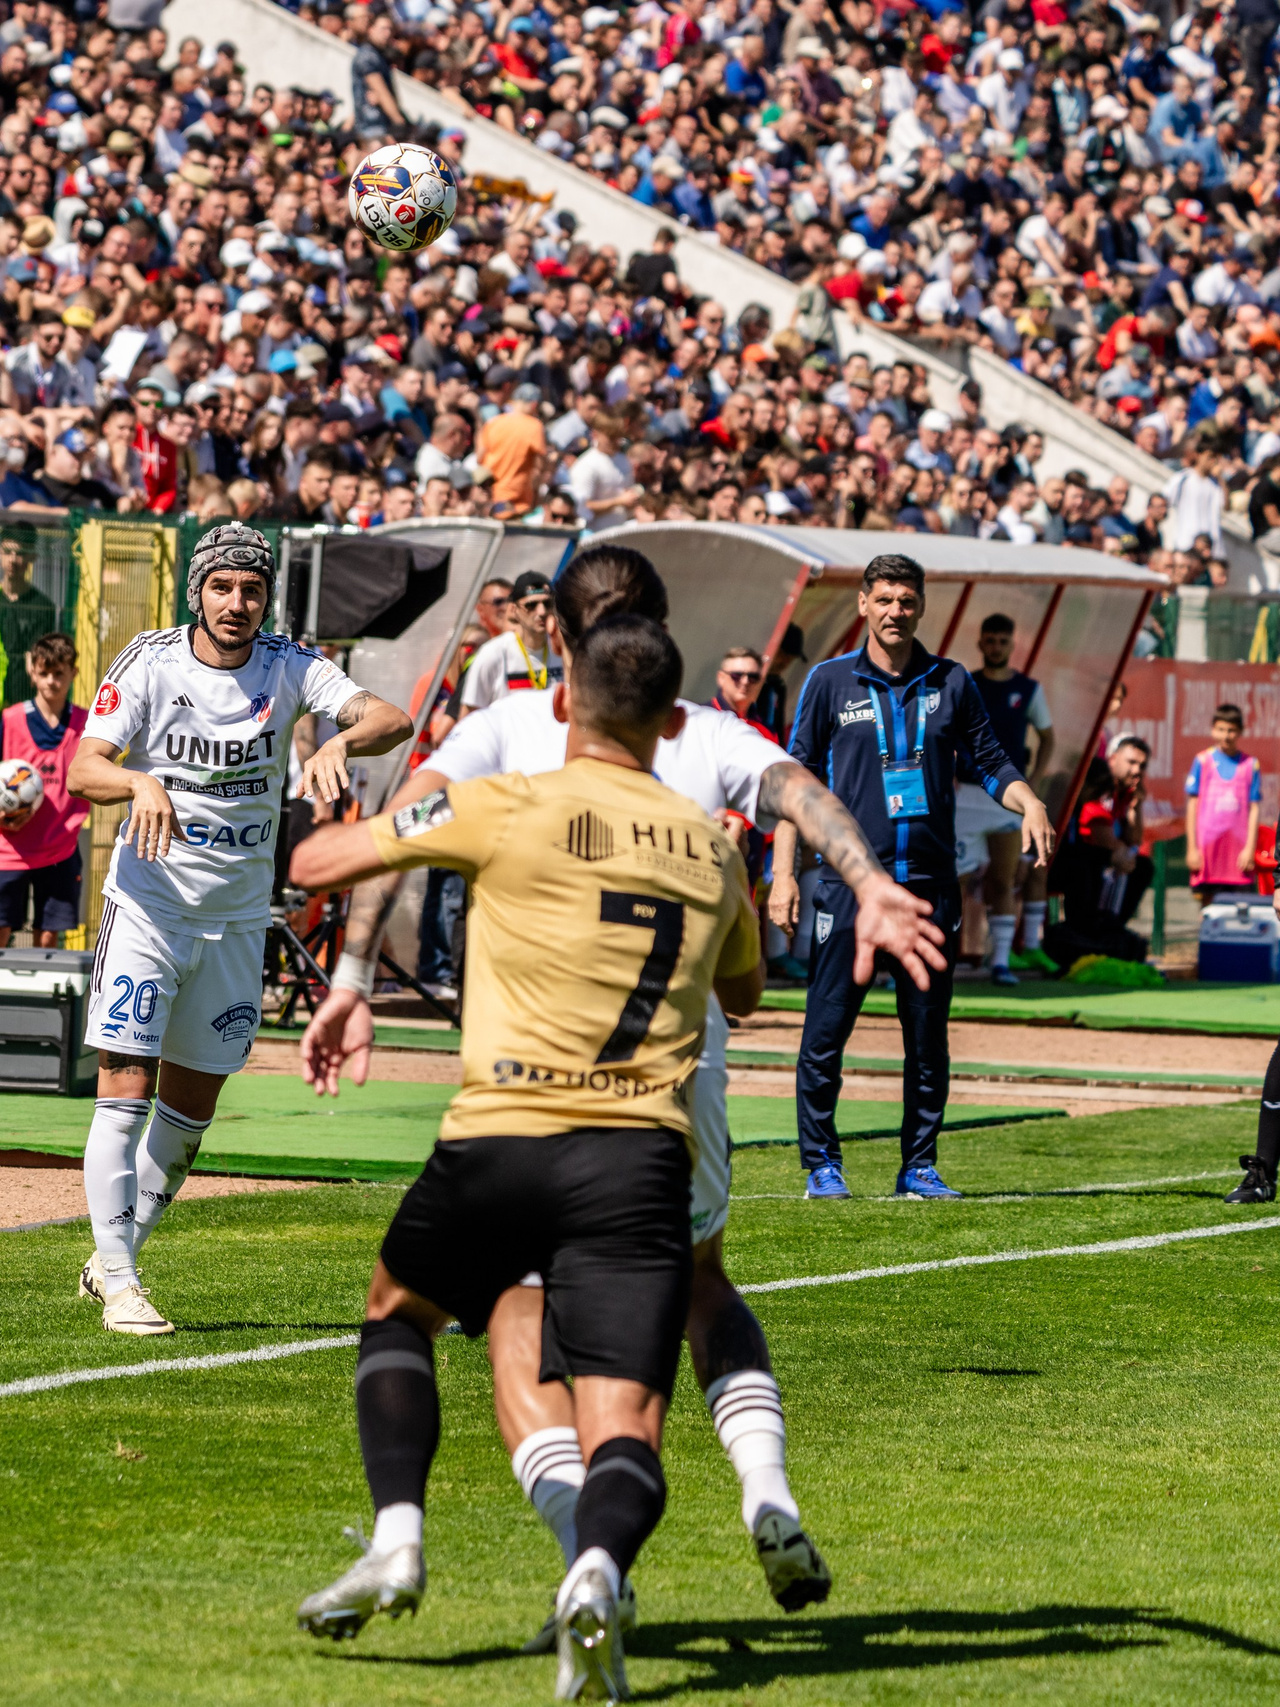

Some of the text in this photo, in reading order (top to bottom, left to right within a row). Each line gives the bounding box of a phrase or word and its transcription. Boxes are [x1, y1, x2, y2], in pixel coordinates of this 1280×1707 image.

[364, 203, 407, 247] SELECT
[839, 709, 876, 725] MAXBE
[166, 730, 276, 767] UNIBET
[226, 783, 251, 797] SPRE
[184, 819, 273, 847] SACO
[632, 822, 722, 868] HILS
[635, 855, 720, 885] DEVELOPMEN
[595, 889, 686, 1065] 7
[108, 974, 159, 1025] 20
[215, 1015, 230, 1029] FIVE
